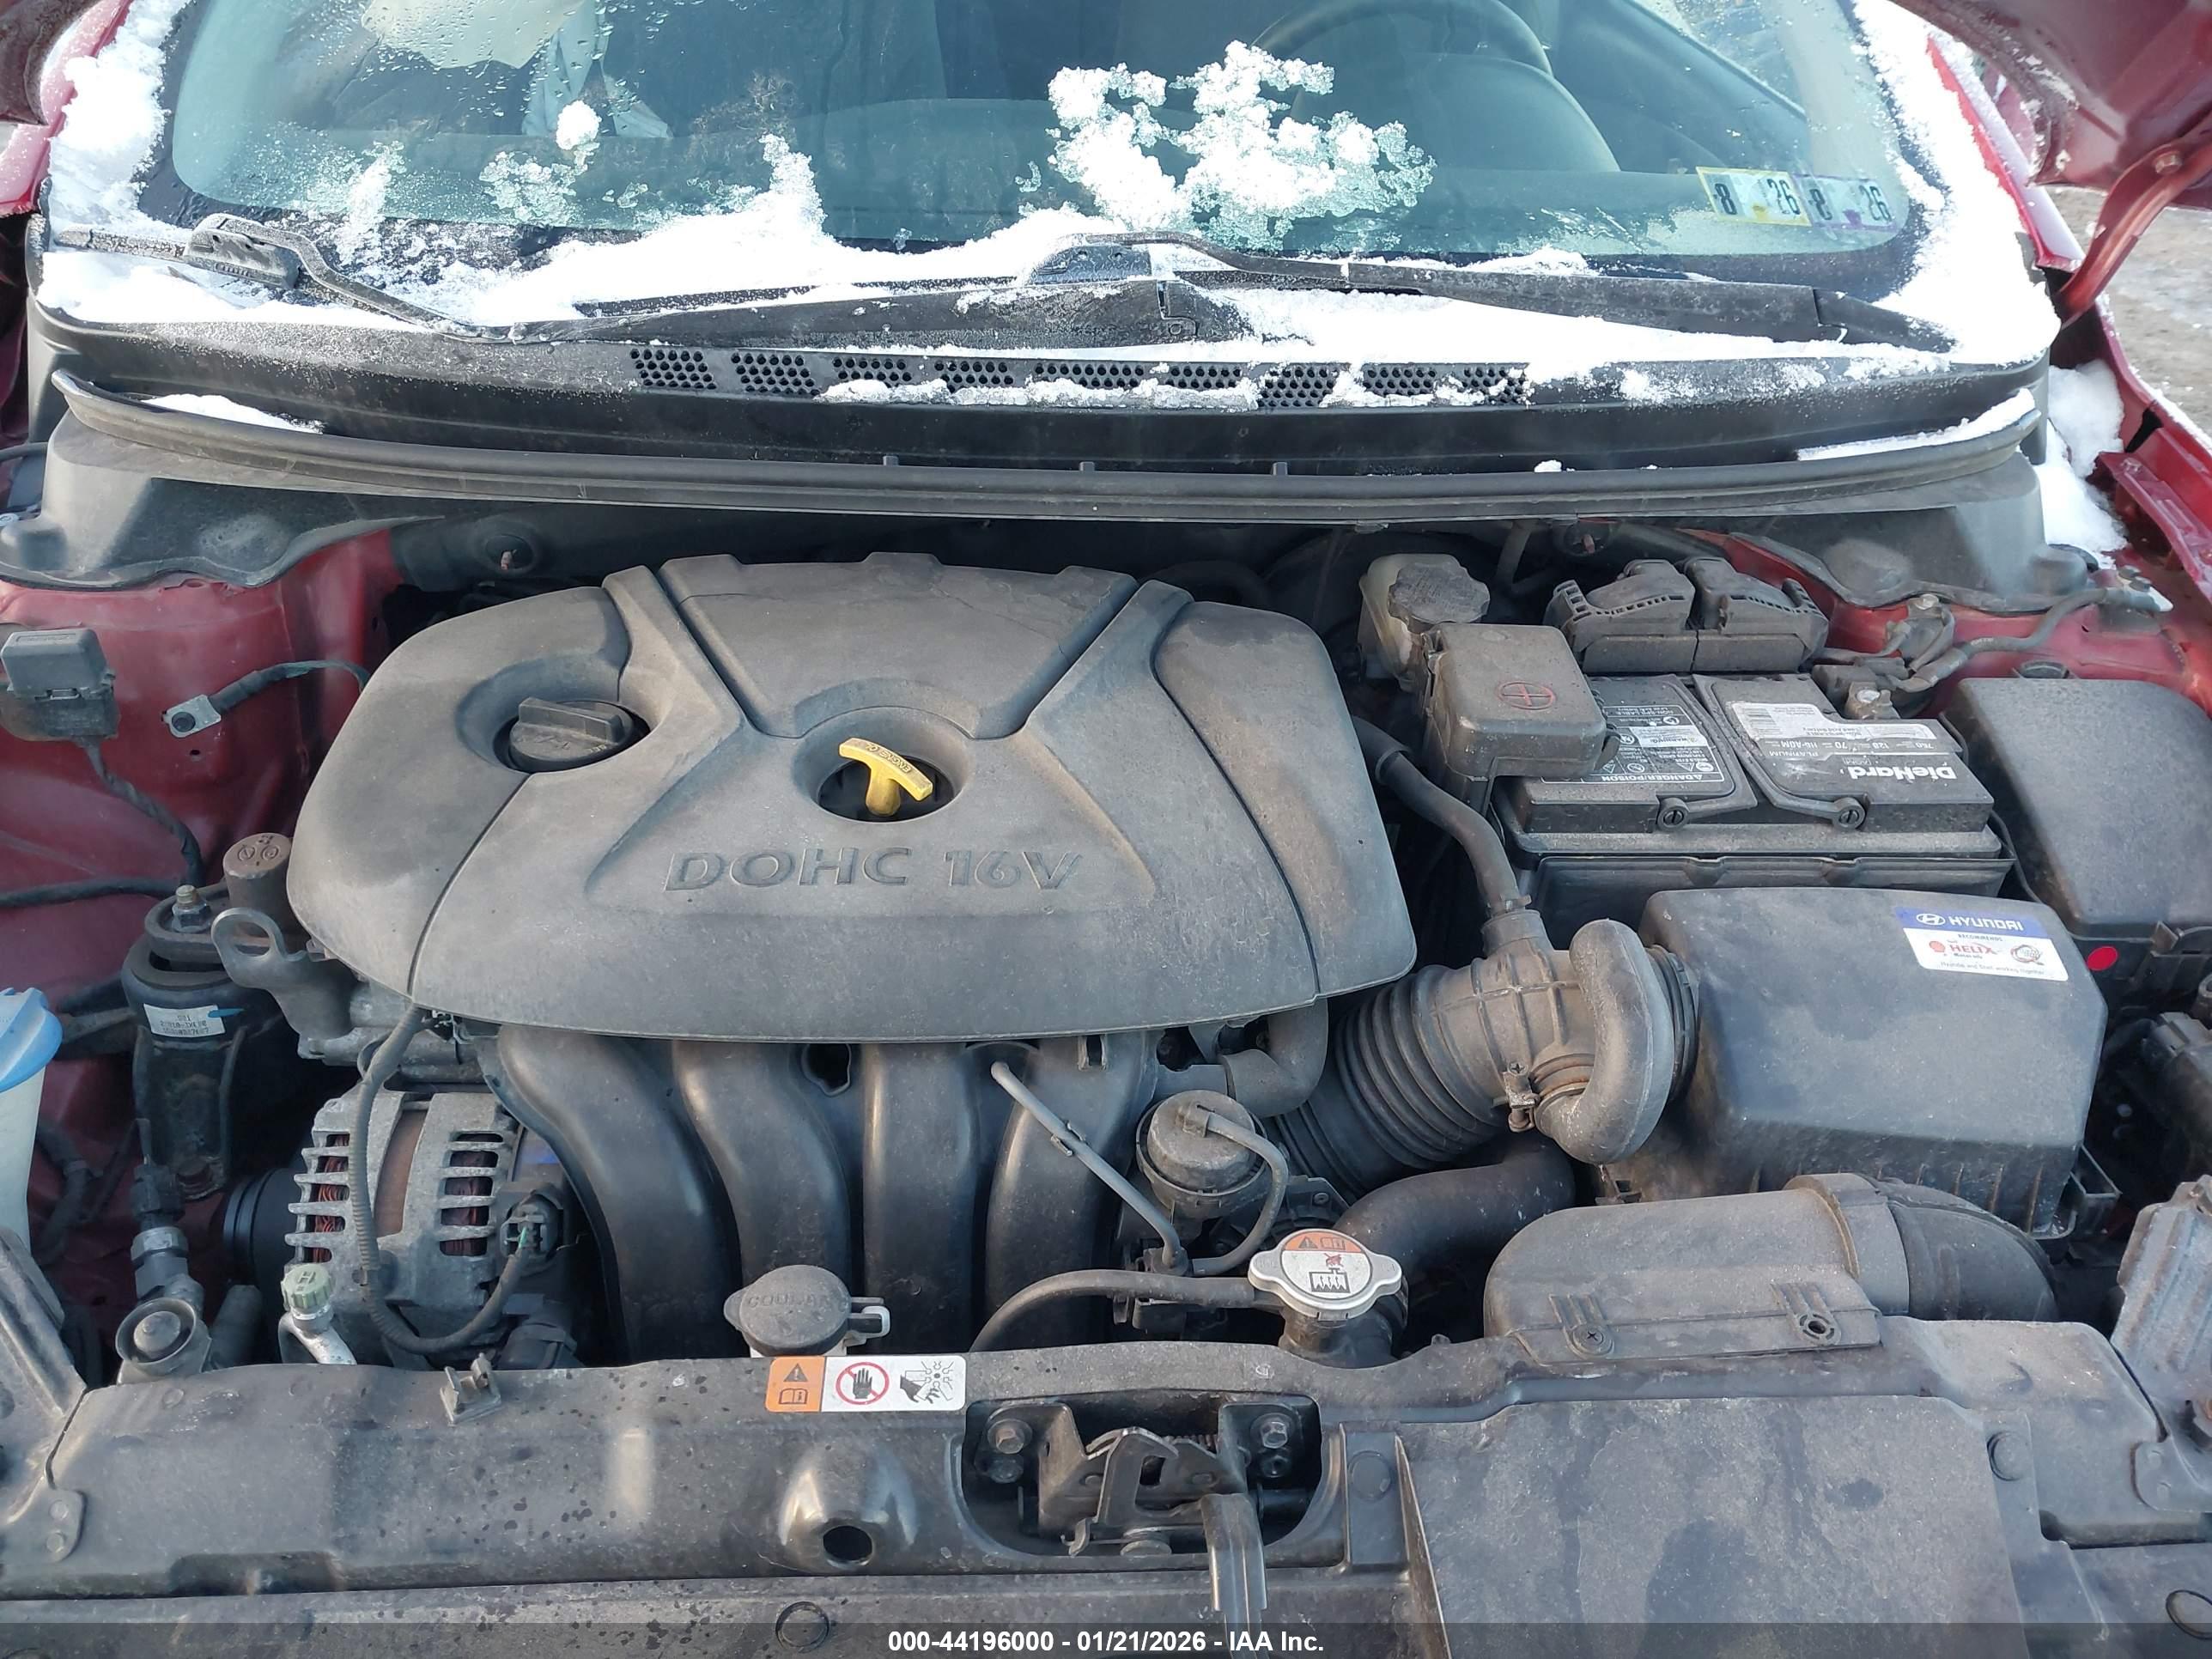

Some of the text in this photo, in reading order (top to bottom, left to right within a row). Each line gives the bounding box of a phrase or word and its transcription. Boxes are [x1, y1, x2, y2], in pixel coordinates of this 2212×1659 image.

[1715, 178, 1801, 216] 8 26
[1859, 184, 1893, 222] 26
[1834, 741, 1848, 750] 70
[1847, 766, 1958, 780] DieHard
[662, 847, 1083, 891] DOHC 16V
[1948, 915, 2025, 932] HYUNDAI
[1949, 941, 1998, 955] HELIX
[296, 1271, 316, 1285] H
